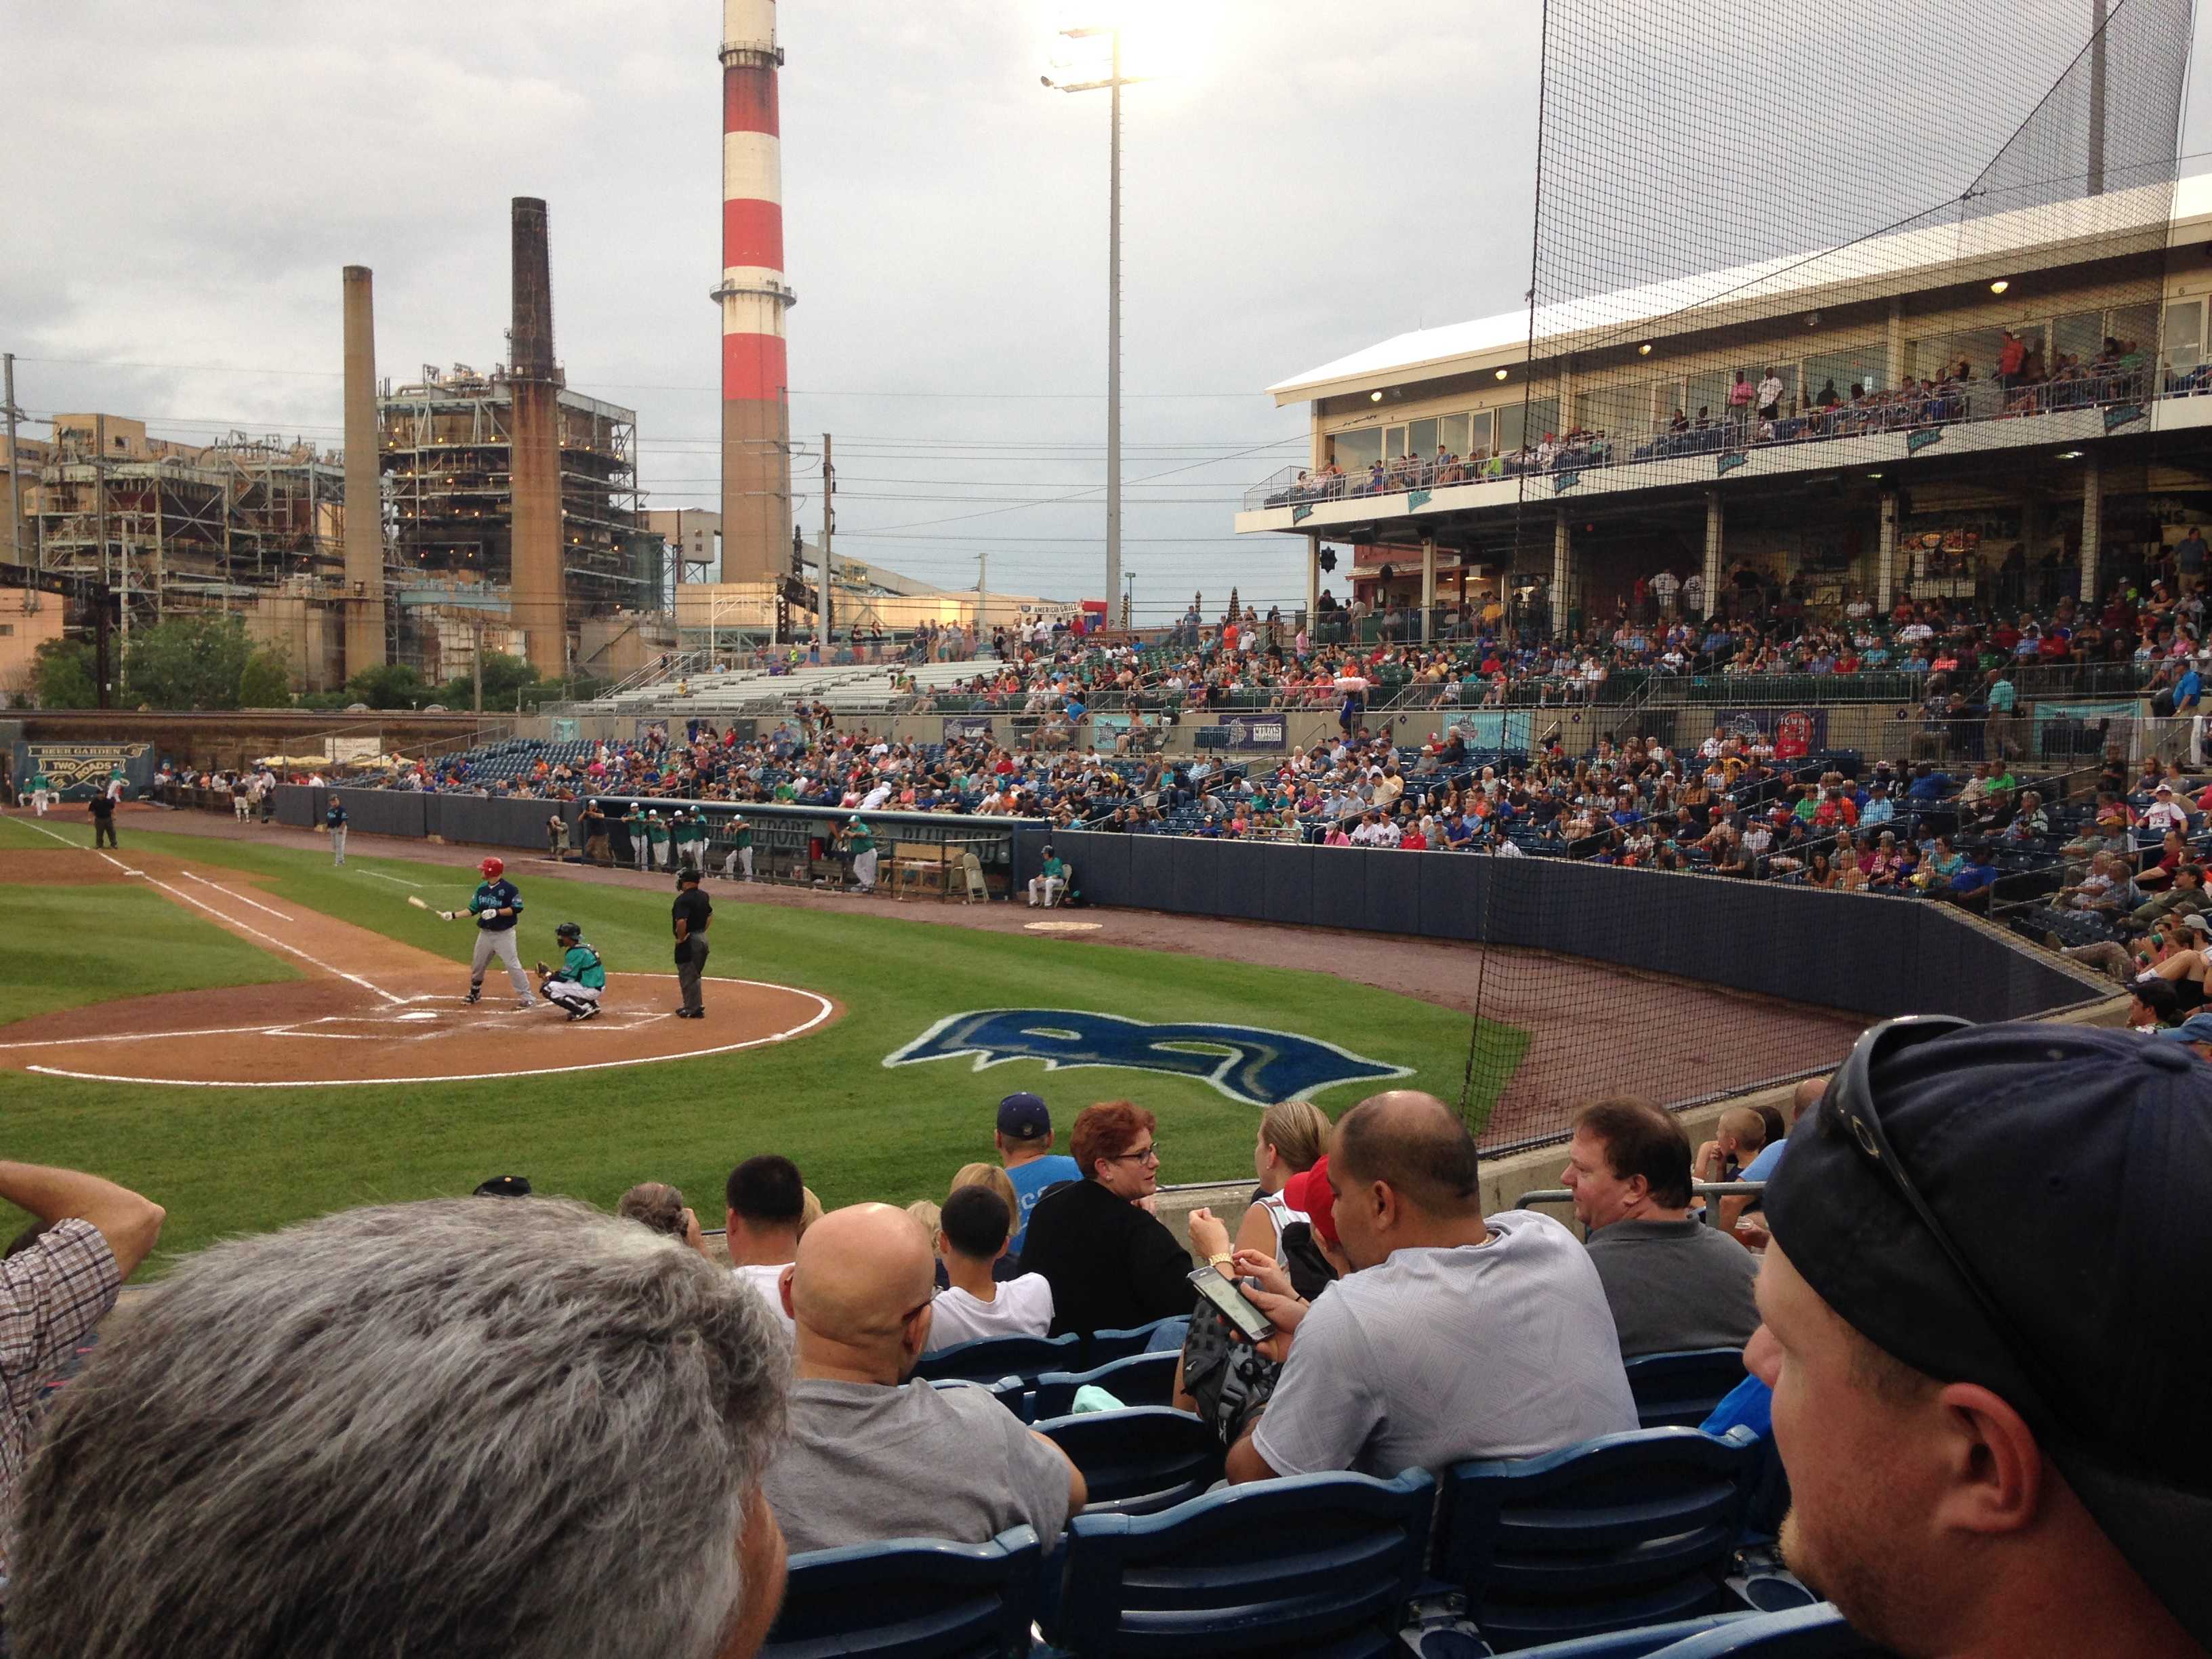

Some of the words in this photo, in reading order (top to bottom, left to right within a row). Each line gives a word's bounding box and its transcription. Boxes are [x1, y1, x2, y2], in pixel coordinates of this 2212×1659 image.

[1059, 603, 1078, 613] GRILL
[54, 761, 76, 771] TWO
[75, 762, 112, 780] ROADS
